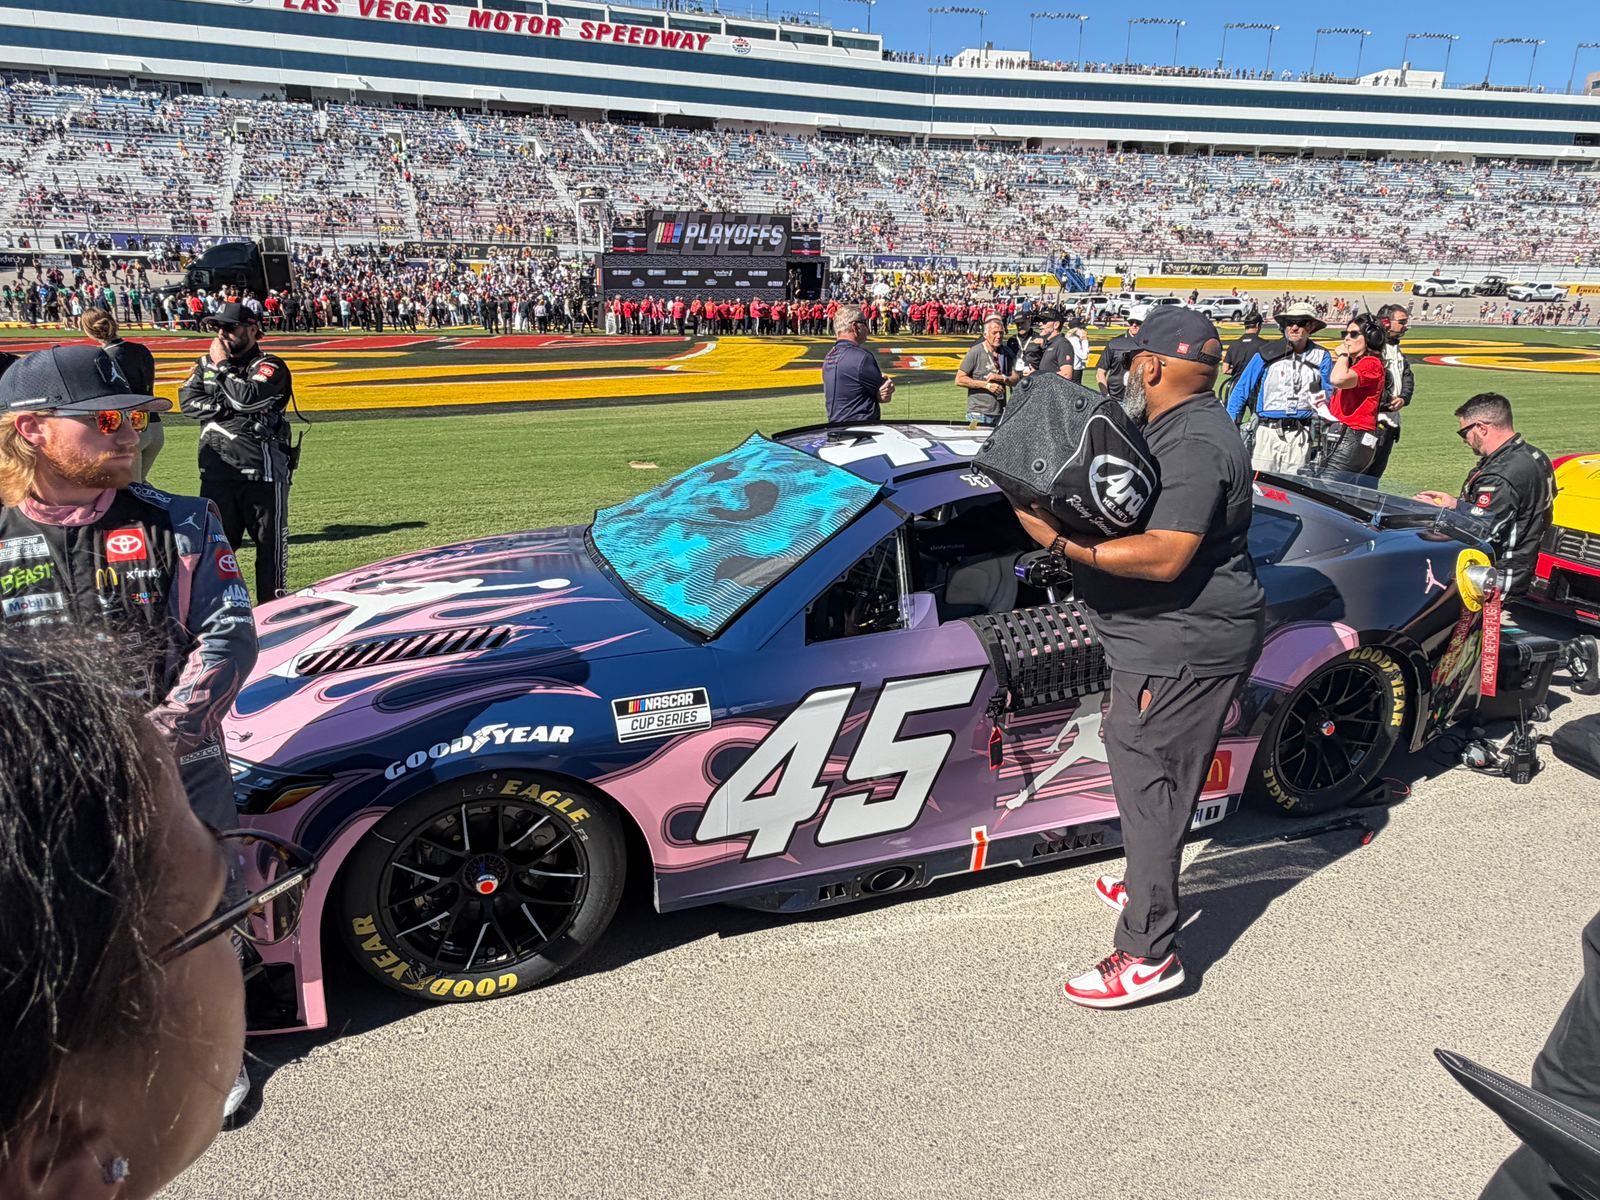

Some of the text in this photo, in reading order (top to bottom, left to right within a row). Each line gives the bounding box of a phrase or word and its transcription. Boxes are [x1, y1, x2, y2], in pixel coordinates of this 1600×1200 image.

[358, 0, 450, 25] VEGAS
[468, 9, 564, 37] MOTOR
[579, 20, 712, 52] SPEEDWAY
[684, 222, 785, 246] PLAYOFFS
[126, 567, 162, 580] xfinity
[9, 598, 44, 613] Mobil
[224, 601, 252, 609] TOOL
[1484, 625, 1497, 654] BEFORE
[1482, 655, 1495, 685] REMOVE
[644, 692, 694, 711] NASCAR
[631, 710, 698, 731] CUP SERIES
[384, 721, 575, 781] GOODYEAR
[693, 665, 989, 862] 45
[500, 779, 592, 824] EAGLE
[1263, 767, 1297, 812] EAGLE
